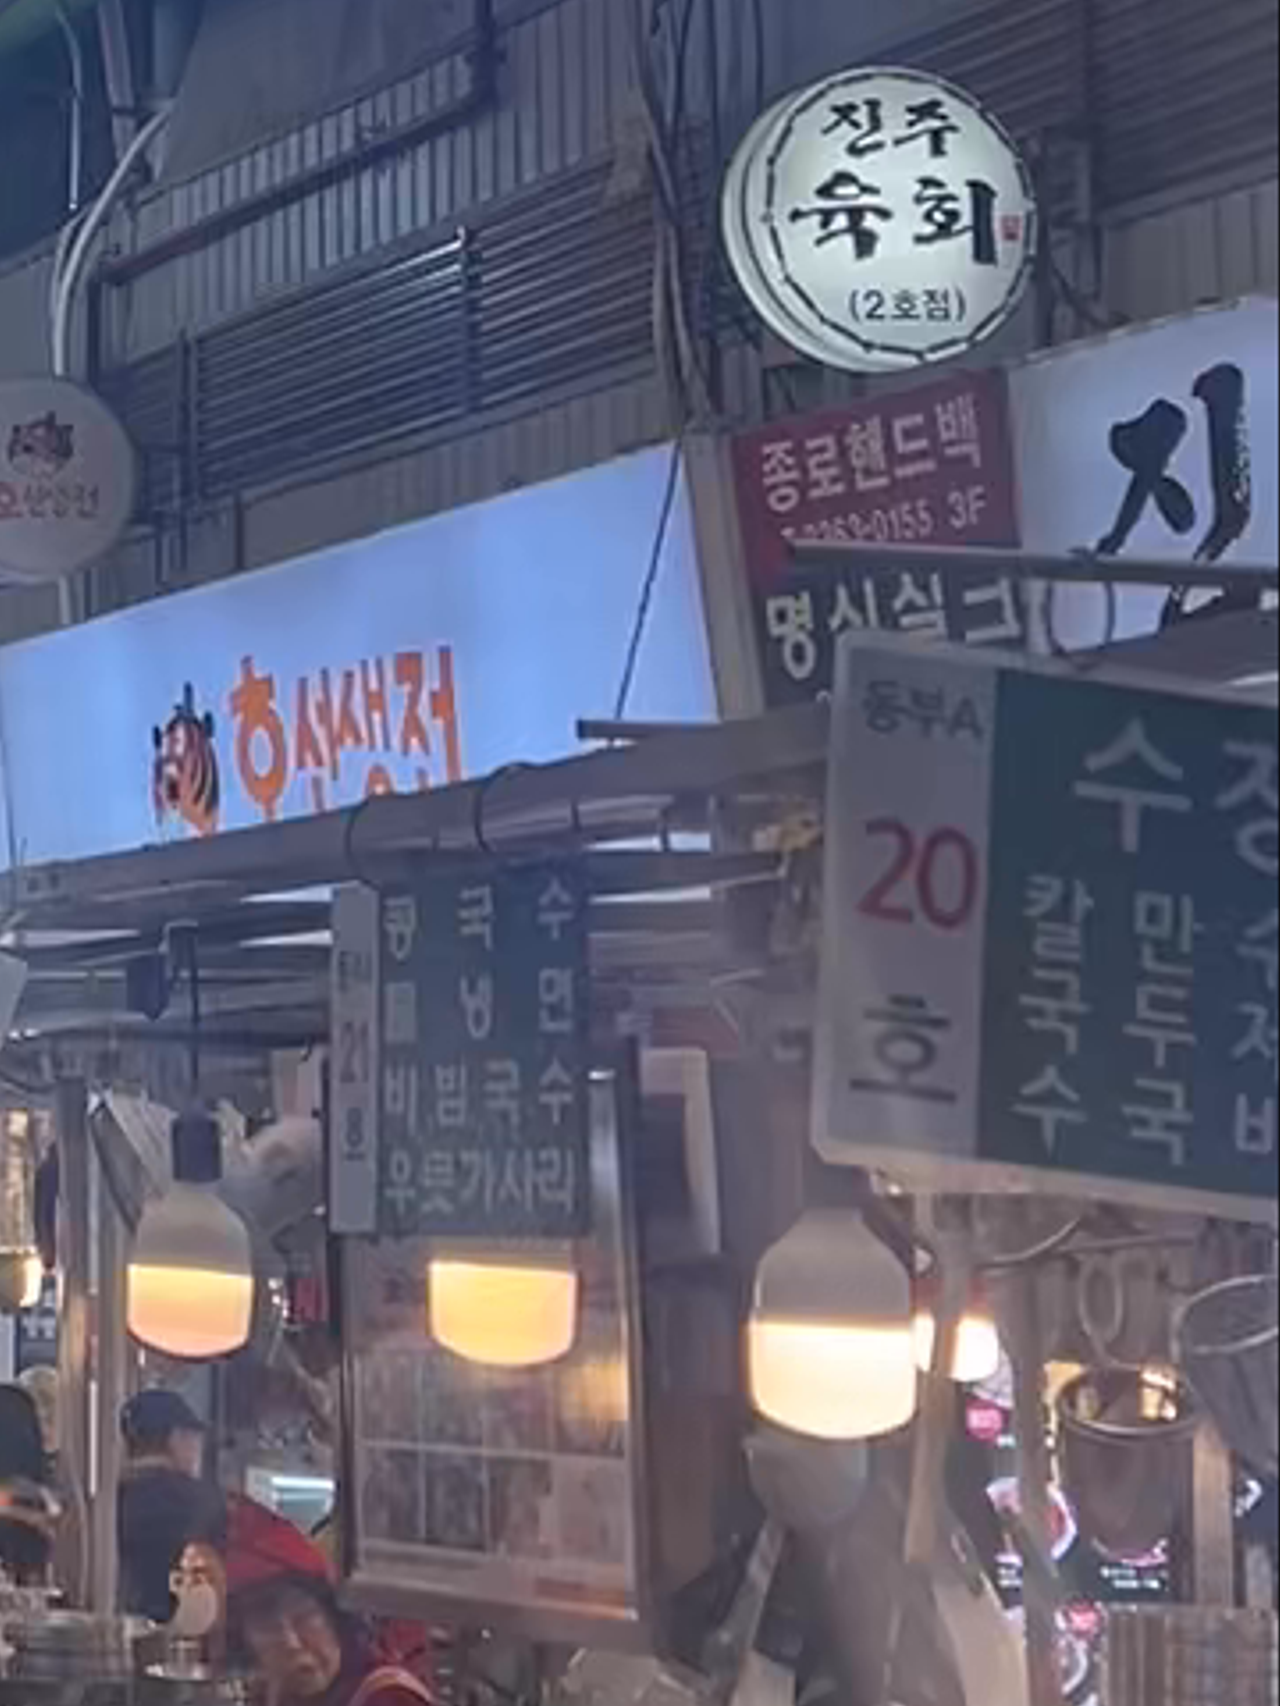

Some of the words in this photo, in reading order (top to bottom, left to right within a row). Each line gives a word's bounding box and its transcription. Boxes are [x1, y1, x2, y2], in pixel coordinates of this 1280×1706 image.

[821, 98, 960, 158] 진주
[788, 169, 998, 267] 육회
[848, 288, 967, 322] (2호점)
[947, 486, 987, 529] 3F
[854, 816, 979, 931] 20
[848, 991, 958, 1106] 호
[1010, 874, 1094, 1156] 칼국수
[1120, 890, 1203, 1166] 만두국
